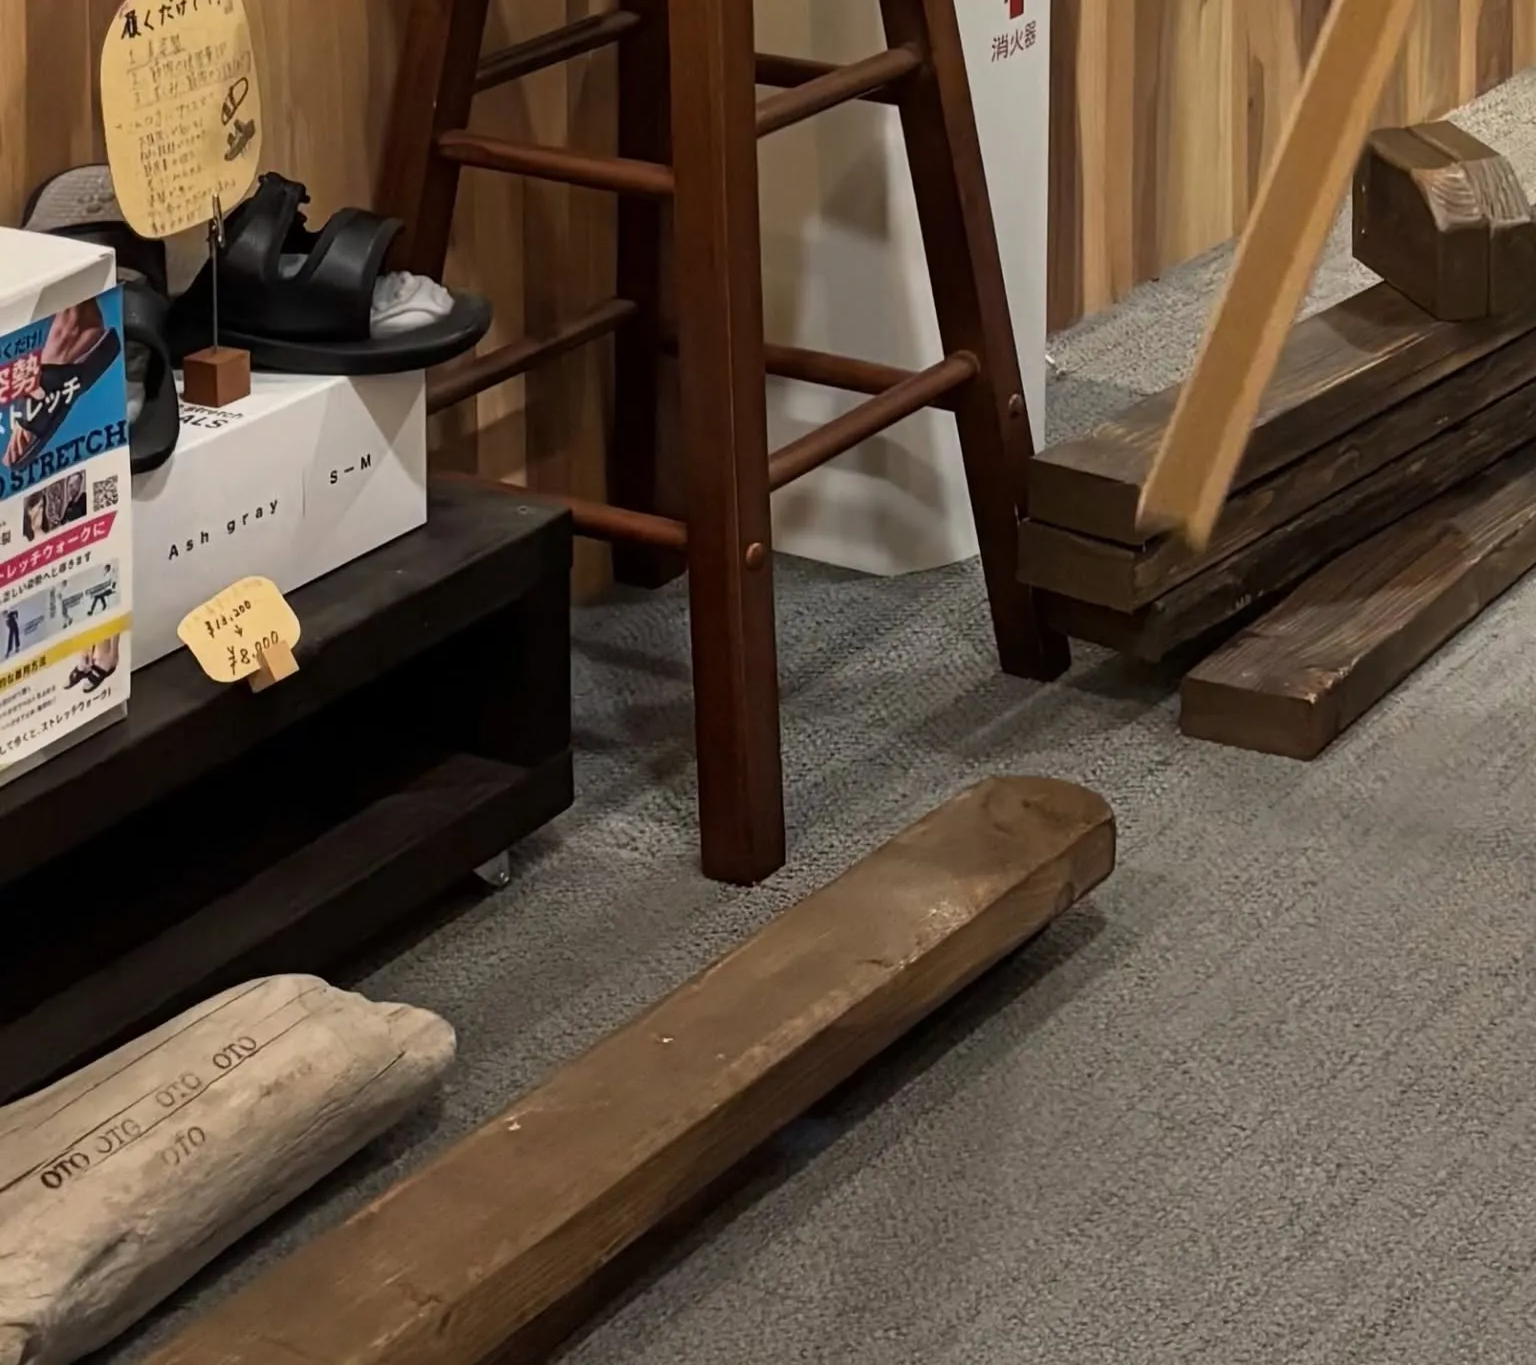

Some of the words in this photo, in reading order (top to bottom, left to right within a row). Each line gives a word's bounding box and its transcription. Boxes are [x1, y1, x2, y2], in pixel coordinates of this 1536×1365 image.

[991, 20, 1036, 62] 消火器
[10, 419, 128, 489] STRETCH
[168, 530, 210, 560] Ash
[226, 499, 279, 535] gray
[41, 1152, 90, 1190] OTO
[156, 1072, 201, 1109] OTO
[212, 1035, 257, 1070] OTO
